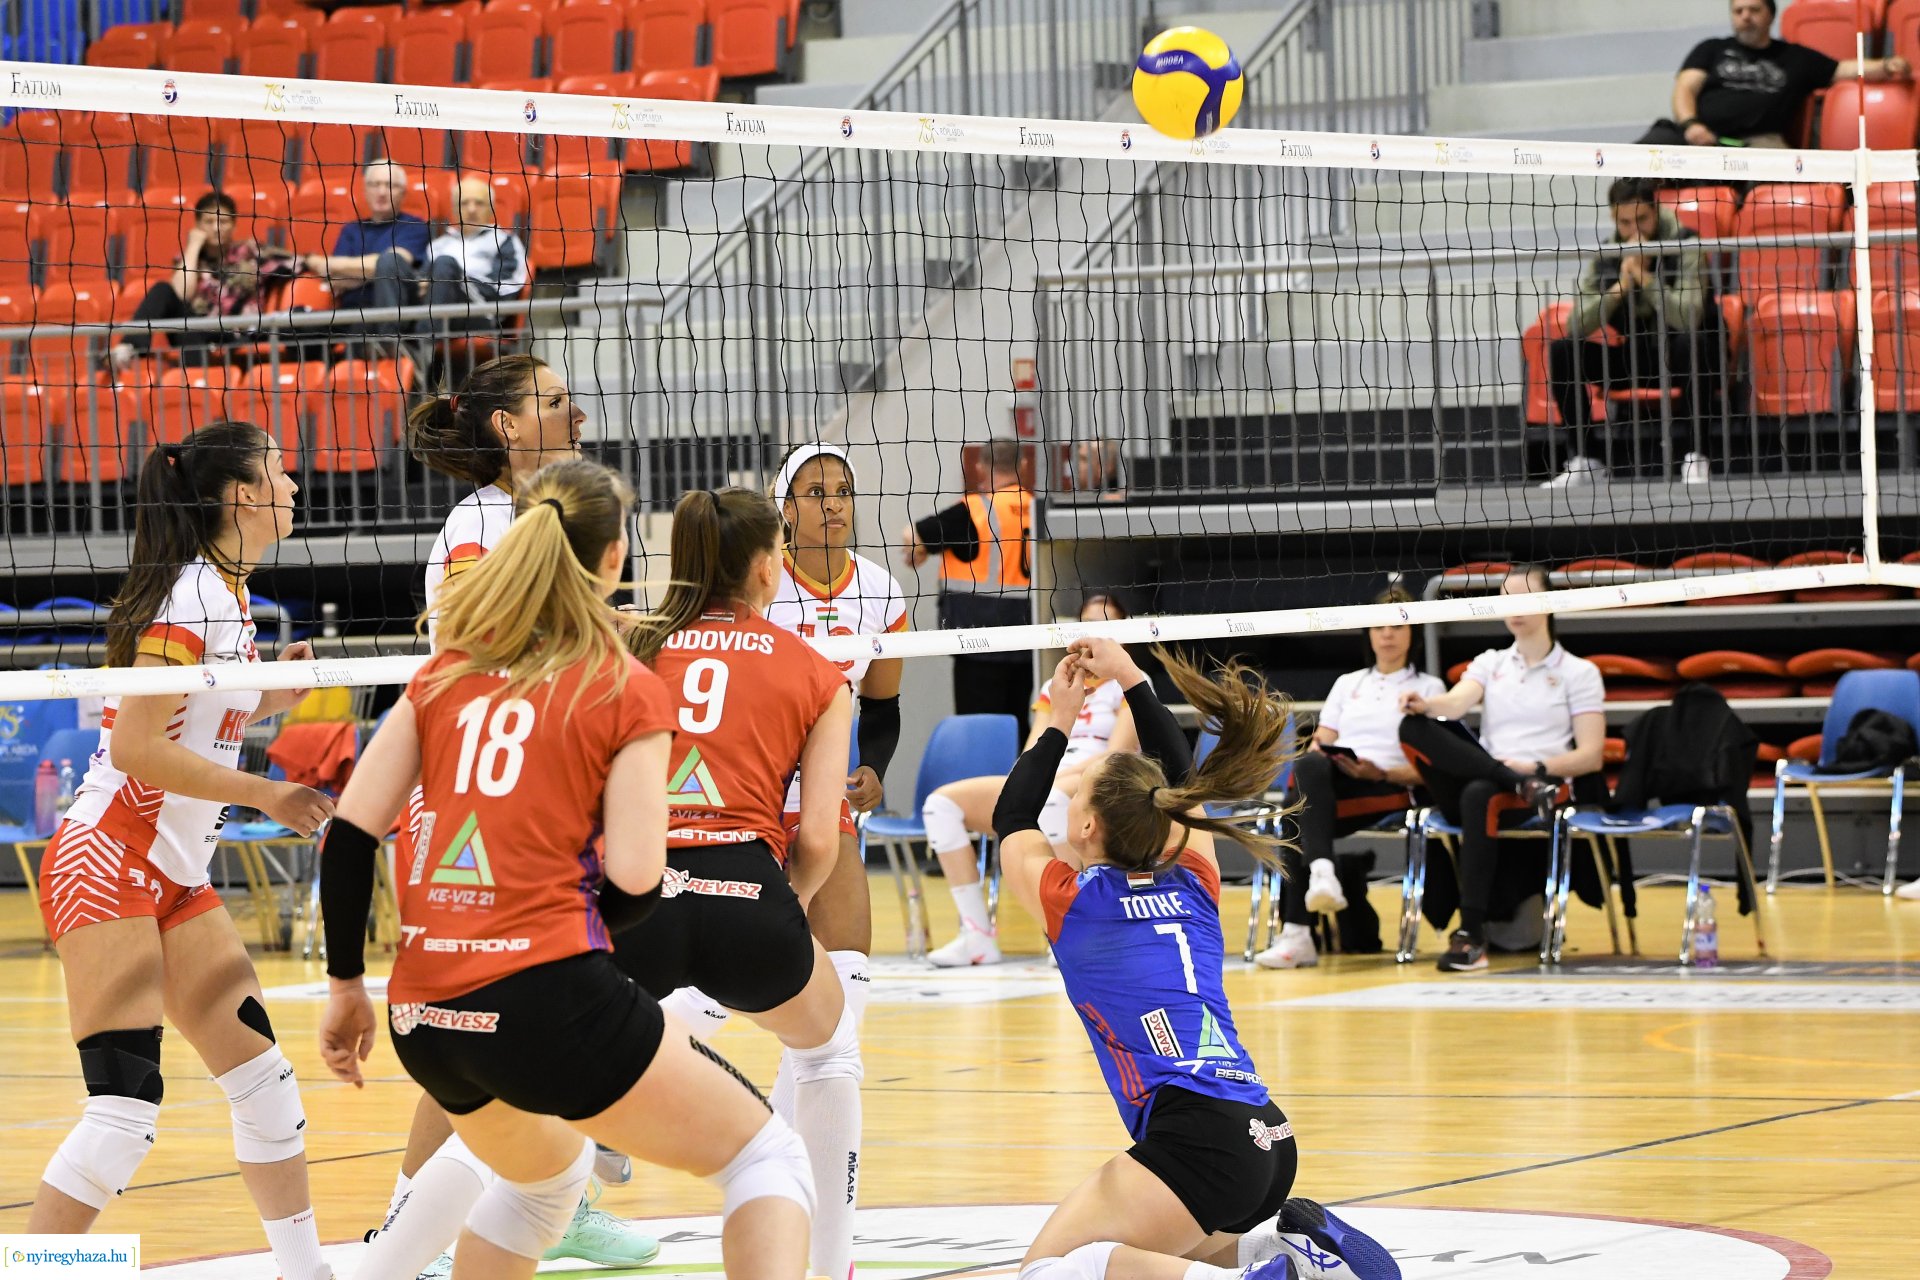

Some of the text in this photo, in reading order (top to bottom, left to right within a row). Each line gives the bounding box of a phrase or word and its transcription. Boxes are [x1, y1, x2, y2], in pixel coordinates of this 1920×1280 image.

[395, 95, 439, 117] FATUM
[726, 112, 766, 133] FATUM
[1019, 126, 1055, 147] FATUM
[1280, 139, 1313, 158] FATUM
[661, 629, 775, 655] ODOVICS
[678, 657, 729, 734] 9
[454, 695, 536, 797] 18
[427, 888, 496, 906] KE-VIZ 21
[423, 937, 531, 953] BESTRONG
[1153, 922, 1199, 994] 7
[421, 1008, 498, 1030] REVESZ
[1149, 1013, 1178, 1058] TRABAG
